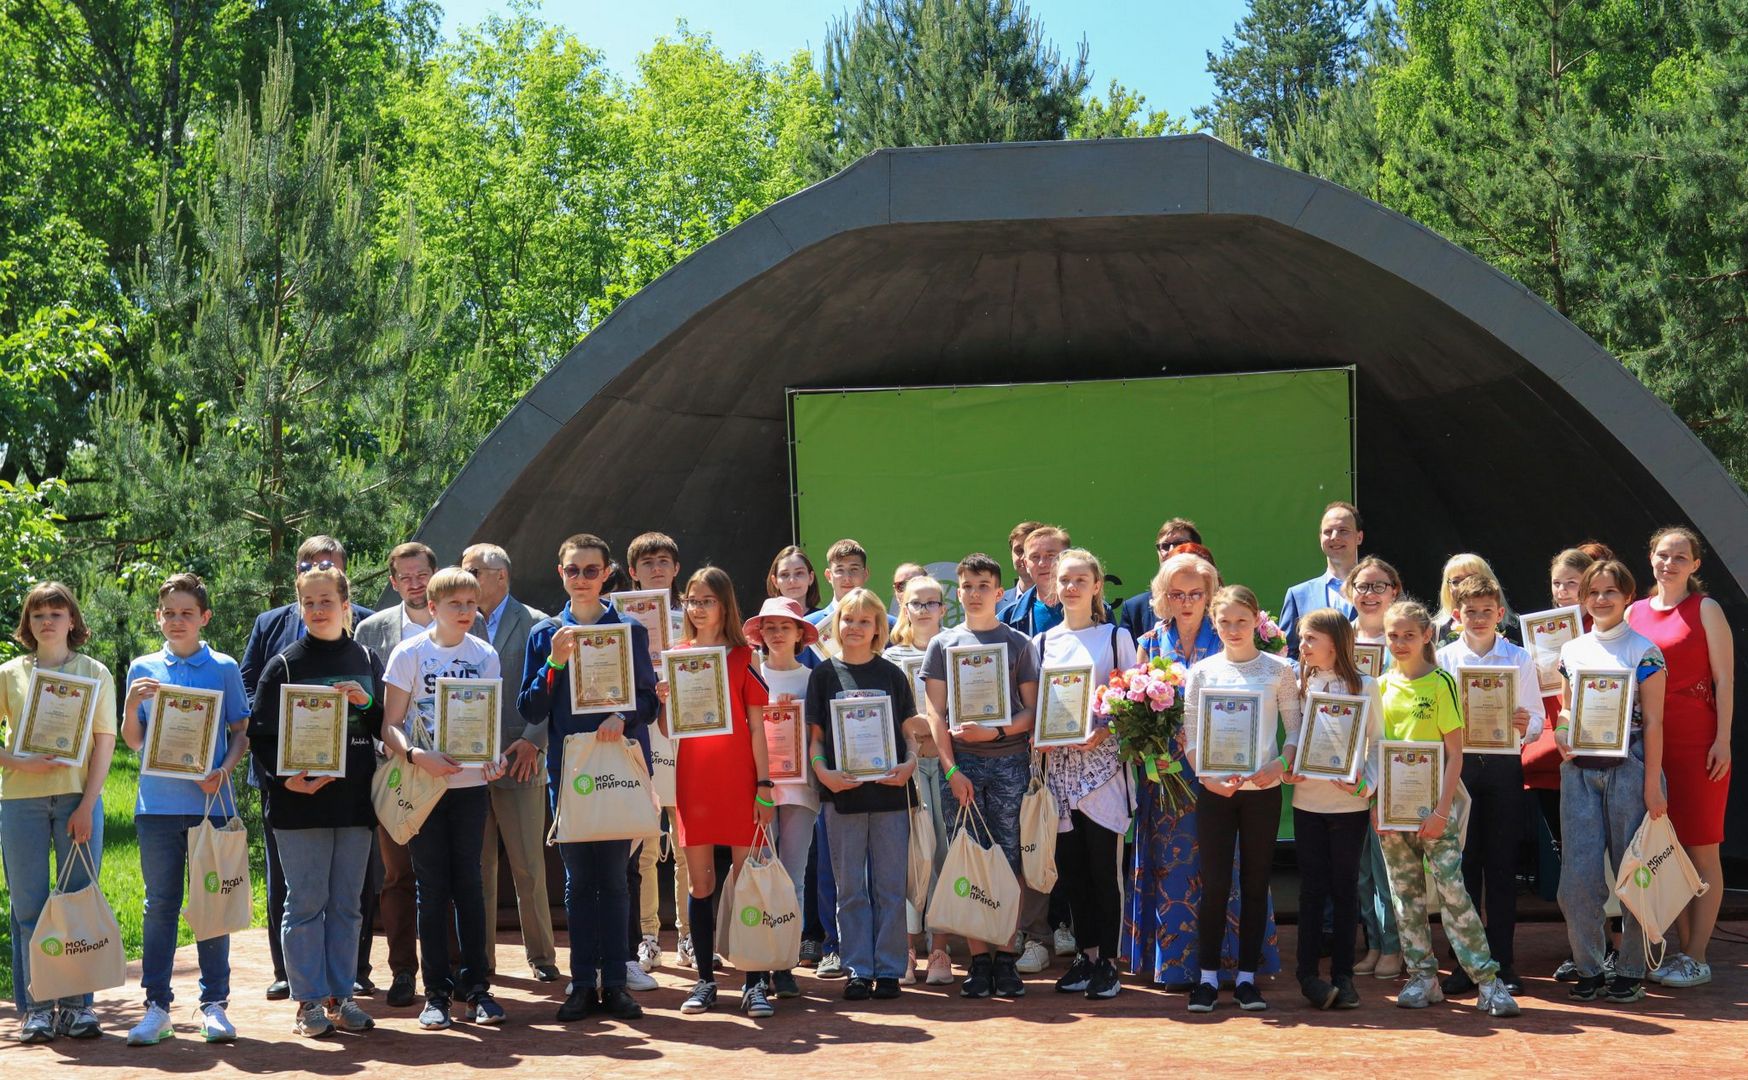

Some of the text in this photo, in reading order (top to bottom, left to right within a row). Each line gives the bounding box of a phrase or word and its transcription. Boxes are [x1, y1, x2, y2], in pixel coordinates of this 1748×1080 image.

[595, 774, 615, 783] МОС
[595, 780, 641, 791] ПРИРОДА
[65, 938, 109, 955] ПРИРОДА
